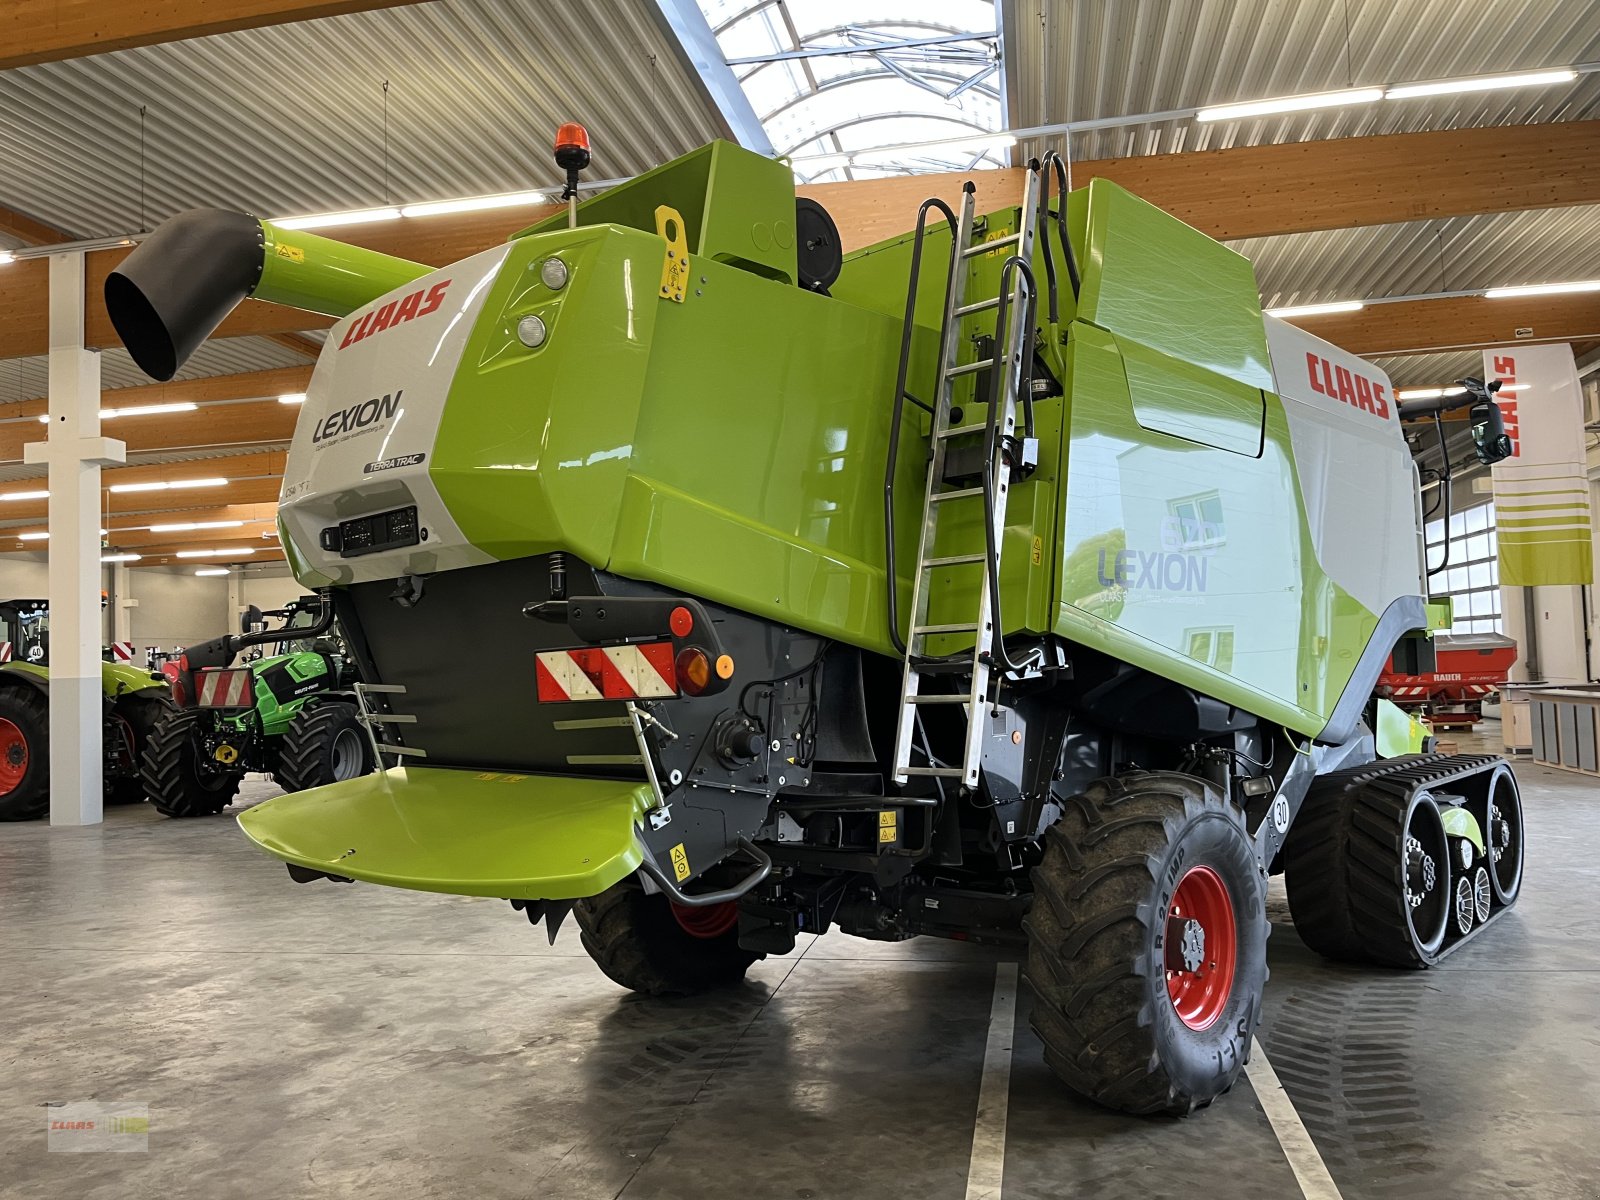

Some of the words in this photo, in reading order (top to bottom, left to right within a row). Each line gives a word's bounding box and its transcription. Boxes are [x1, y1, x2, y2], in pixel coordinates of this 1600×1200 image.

[338, 279, 453, 350] CLAAS
[1306, 352, 1390, 420] CLAAS
[312, 390, 403, 443] LEXION
[369, 459, 395, 472] TERRA
[396, 455, 419, 468] TRAC
[1097, 547, 1207, 592] LEXION
[32, 647, 42, 657] 40
[1433, 673, 1461, 682] RAUCH
[1276, 801, 1287, 826] 30
[1167, 847, 1185, 886] IMP
[1158, 891, 1169, 921] 24
[1154, 935, 1164, 950] R
